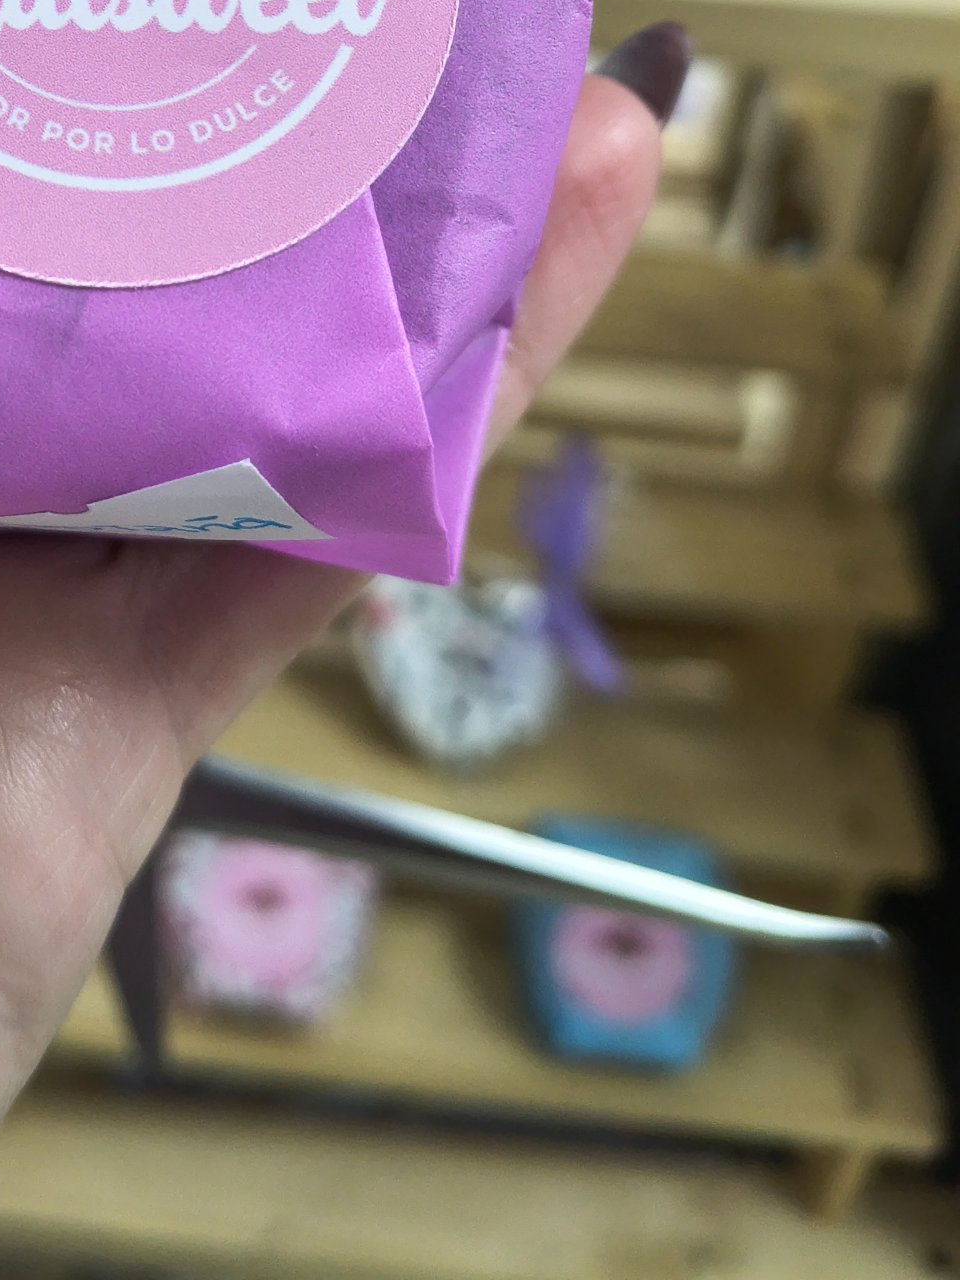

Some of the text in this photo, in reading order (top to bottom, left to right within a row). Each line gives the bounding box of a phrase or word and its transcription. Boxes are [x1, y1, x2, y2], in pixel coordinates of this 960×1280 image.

[42, 120, 115, 155] POR
[131, 129, 173, 155] LO
[190, 69, 296, 143] DULCE
